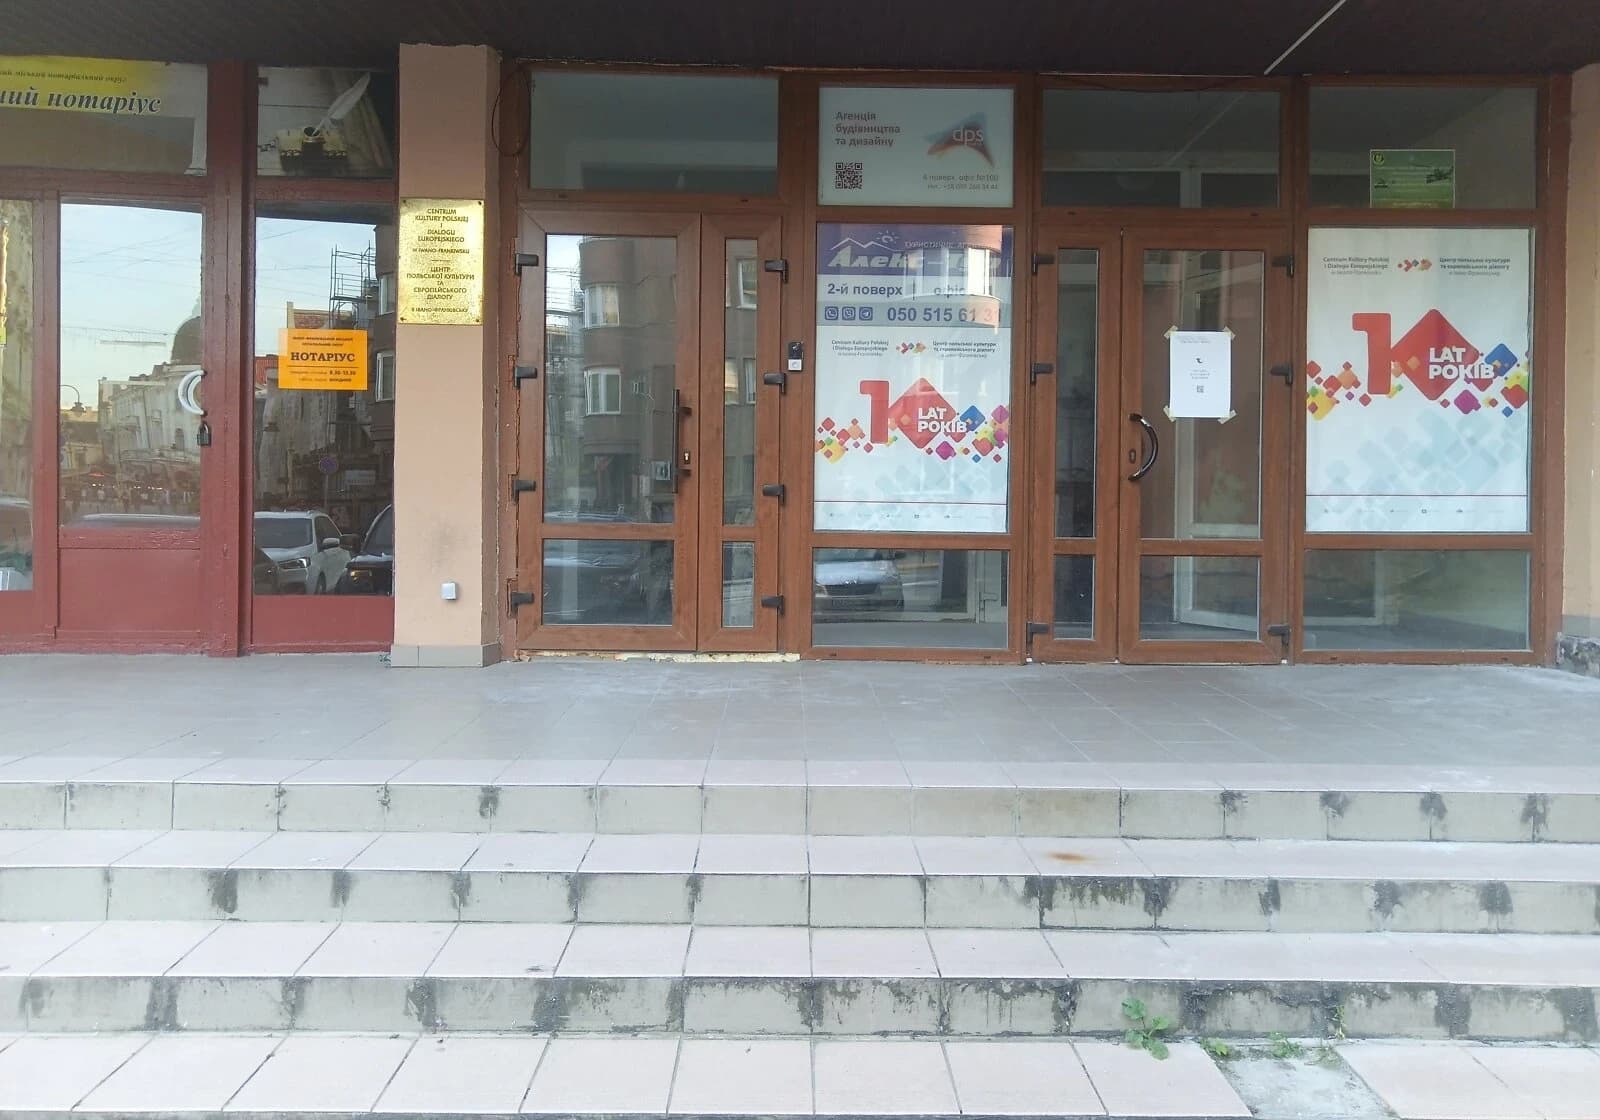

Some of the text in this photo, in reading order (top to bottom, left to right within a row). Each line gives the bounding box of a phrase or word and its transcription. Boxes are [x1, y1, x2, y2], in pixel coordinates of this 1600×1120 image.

[47, 88, 161, 114] нотаріус
[835, 112, 877, 122] Агенція
[835, 123, 901, 135] будівництва
[835, 136, 894, 148] та дизайну
[952, 126, 984, 148] dps
[442, 215, 469, 223] POLSKIEJ
[444, 273, 475, 281] КУЛЬТУРИ
[413, 286, 467, 294] ЄВРОПЕЙСЬКОГО
[827, 282, 849, 296] 2-й
[853, 285, 903, 299] поверх
[887, 307, 918, 322] 050
[922, 307, 953, 322] 515
[958, 308, 976, 322] 61
[290, 351, 356, 362] НОТАРІУС
[1428, 345, 1467, 364] LAT
[1428, 363, 1496, 381] РОКІВ
[917, 407, 947, 420] LAT
[917, 420, 968, 433] РОКІВ
